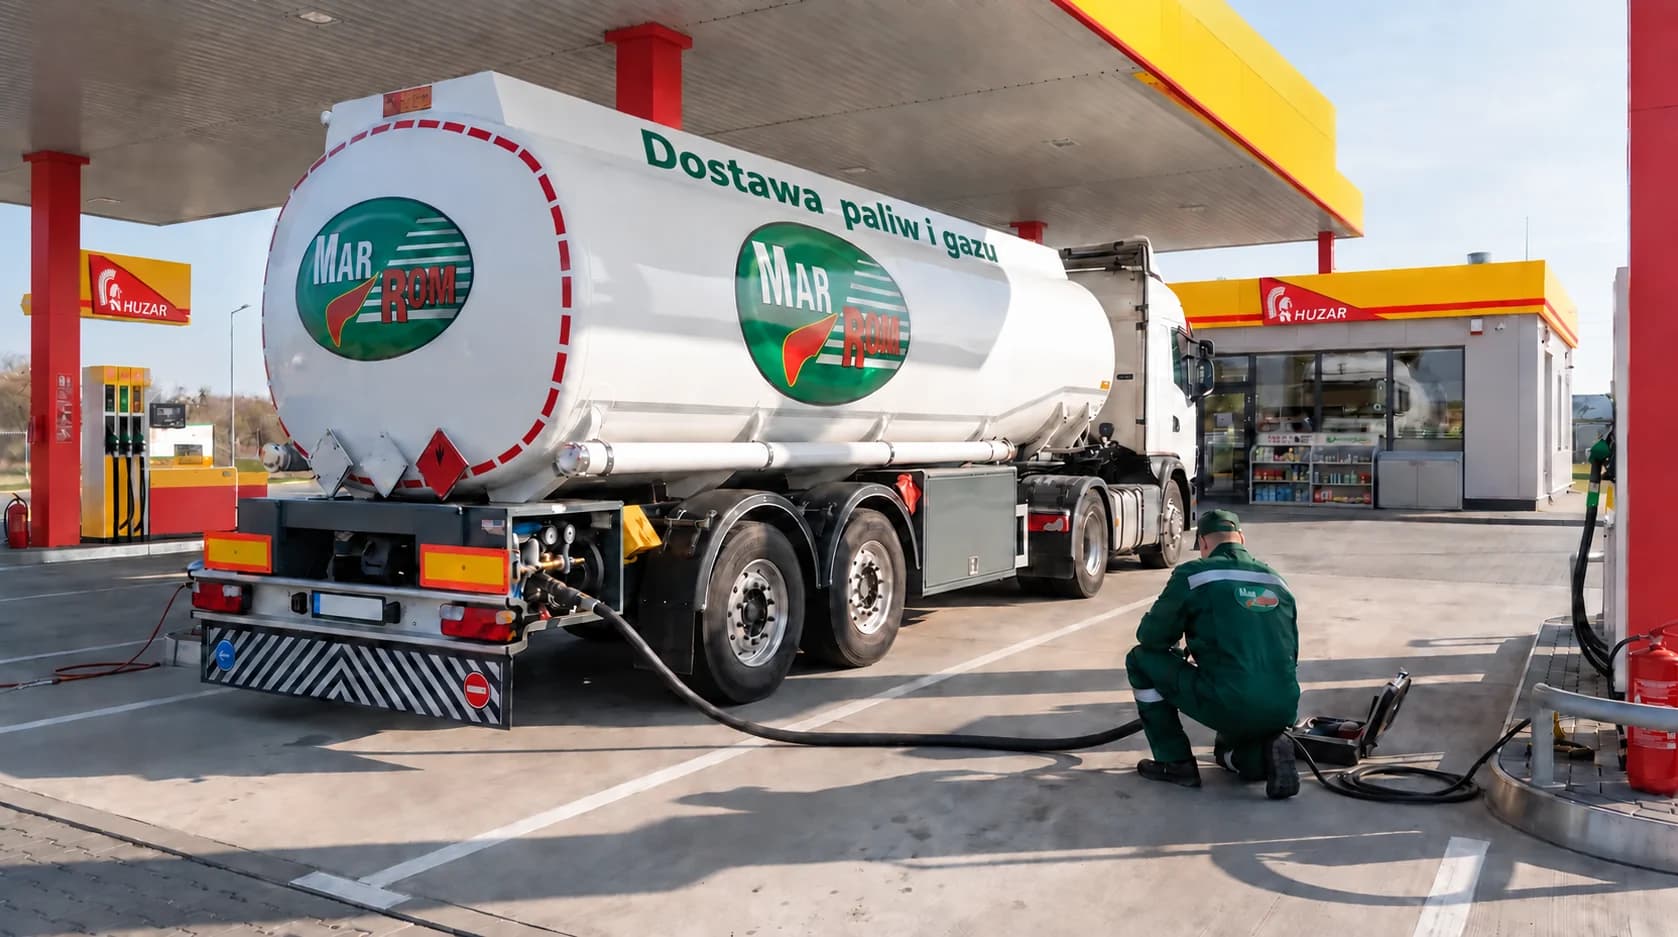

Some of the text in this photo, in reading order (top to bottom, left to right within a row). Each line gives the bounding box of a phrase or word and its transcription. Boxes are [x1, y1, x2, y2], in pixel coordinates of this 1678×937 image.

[641, 128, 999, 264] Dostawa paliw i gazu
[313, 232, 373, 285] MAR
[751, 240, 832, 314] MAR
[123, 300, 168, 316] HUZAR
[380, 265, 457, 324] ROM
[1294, 307, 1347, 321] HUZAR
[841, 305, 900, 369] ROM
